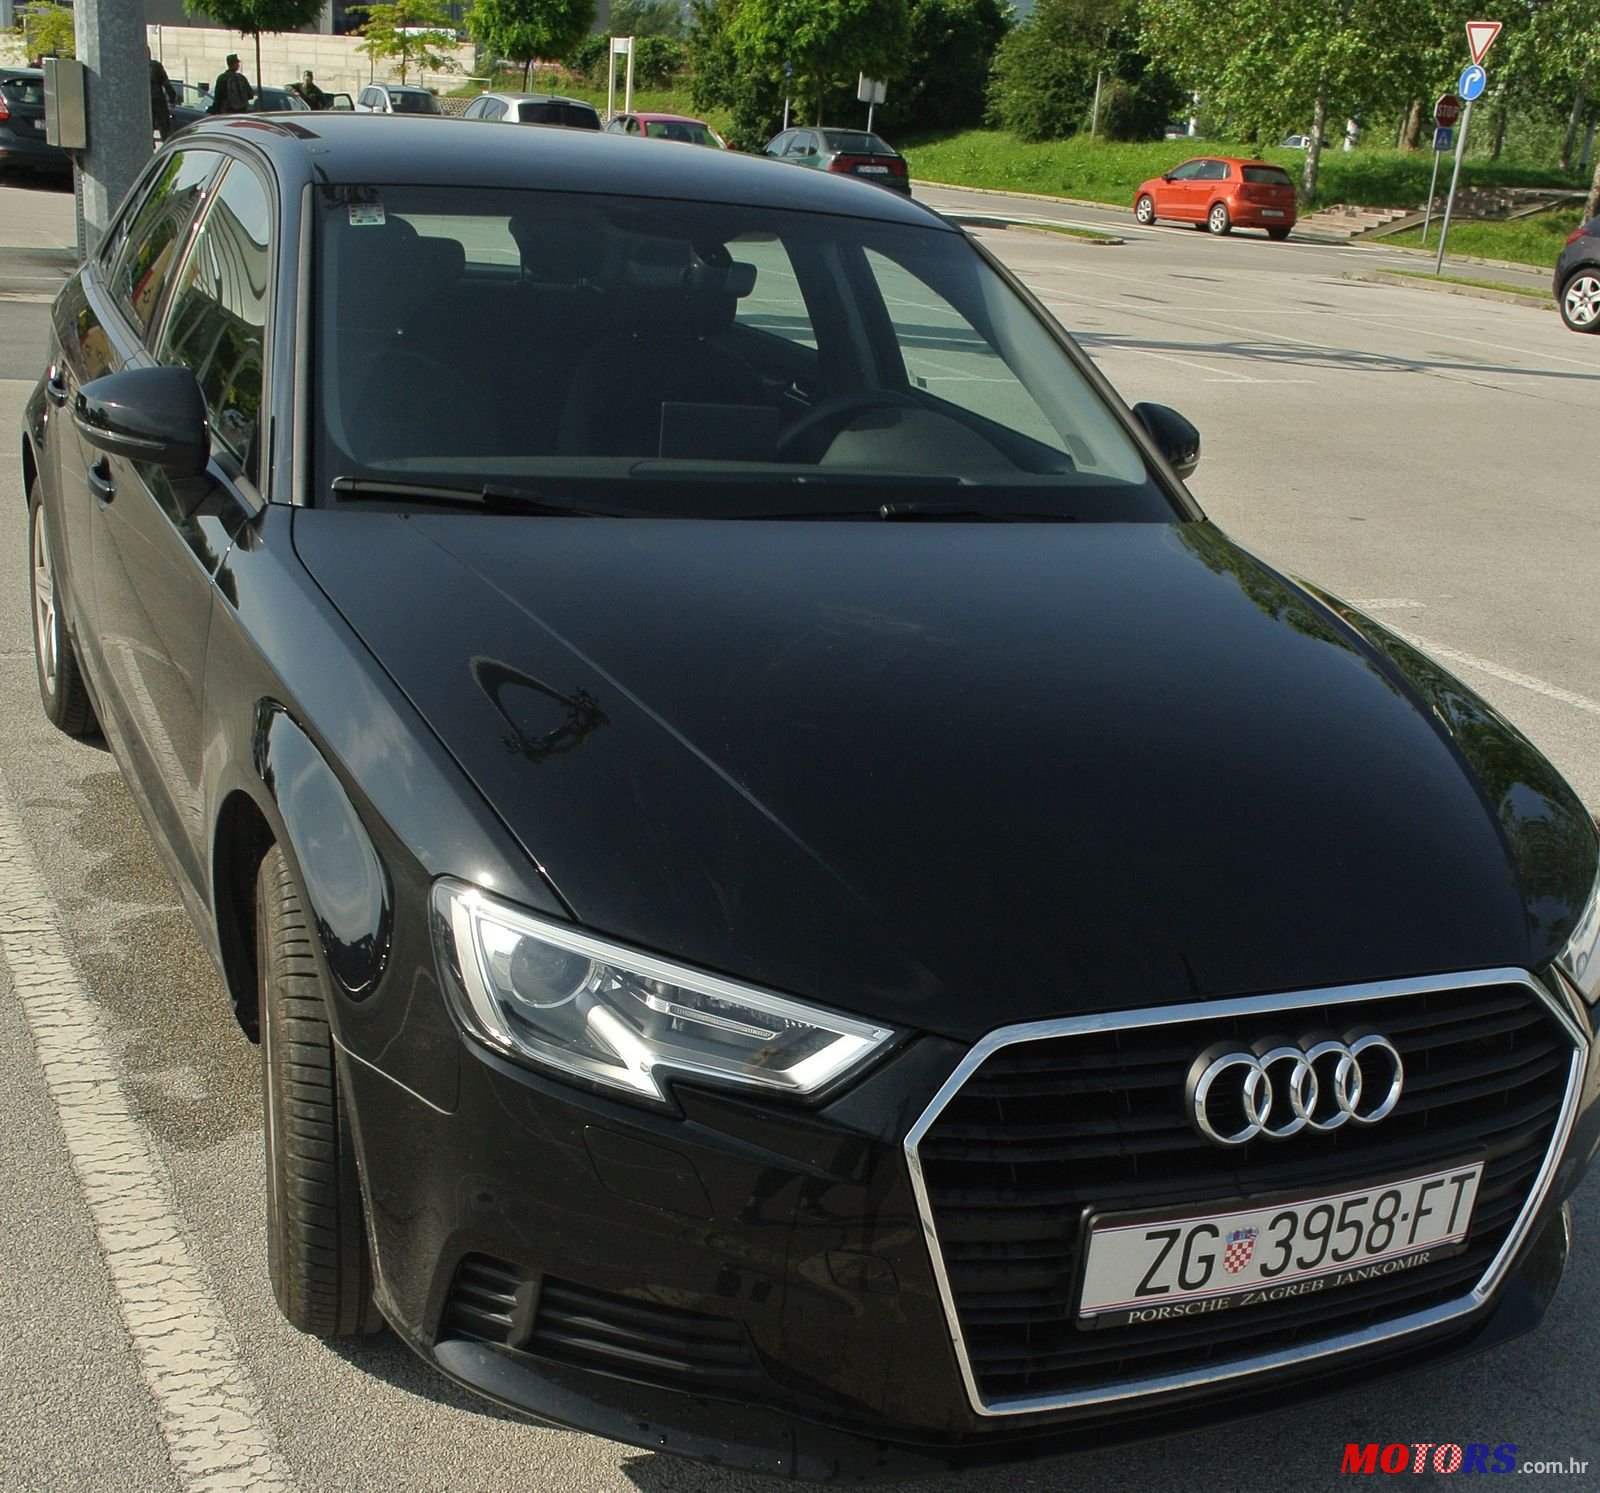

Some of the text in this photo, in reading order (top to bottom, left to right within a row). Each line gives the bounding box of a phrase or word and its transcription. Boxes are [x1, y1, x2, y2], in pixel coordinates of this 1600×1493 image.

[1437, 104, 1458, 118] STOP
[1128, 1251, 1431, 1325] PORSCHE ZAGREB JANKOMIR
[1135, 1223, 1220, 1297] ZG
